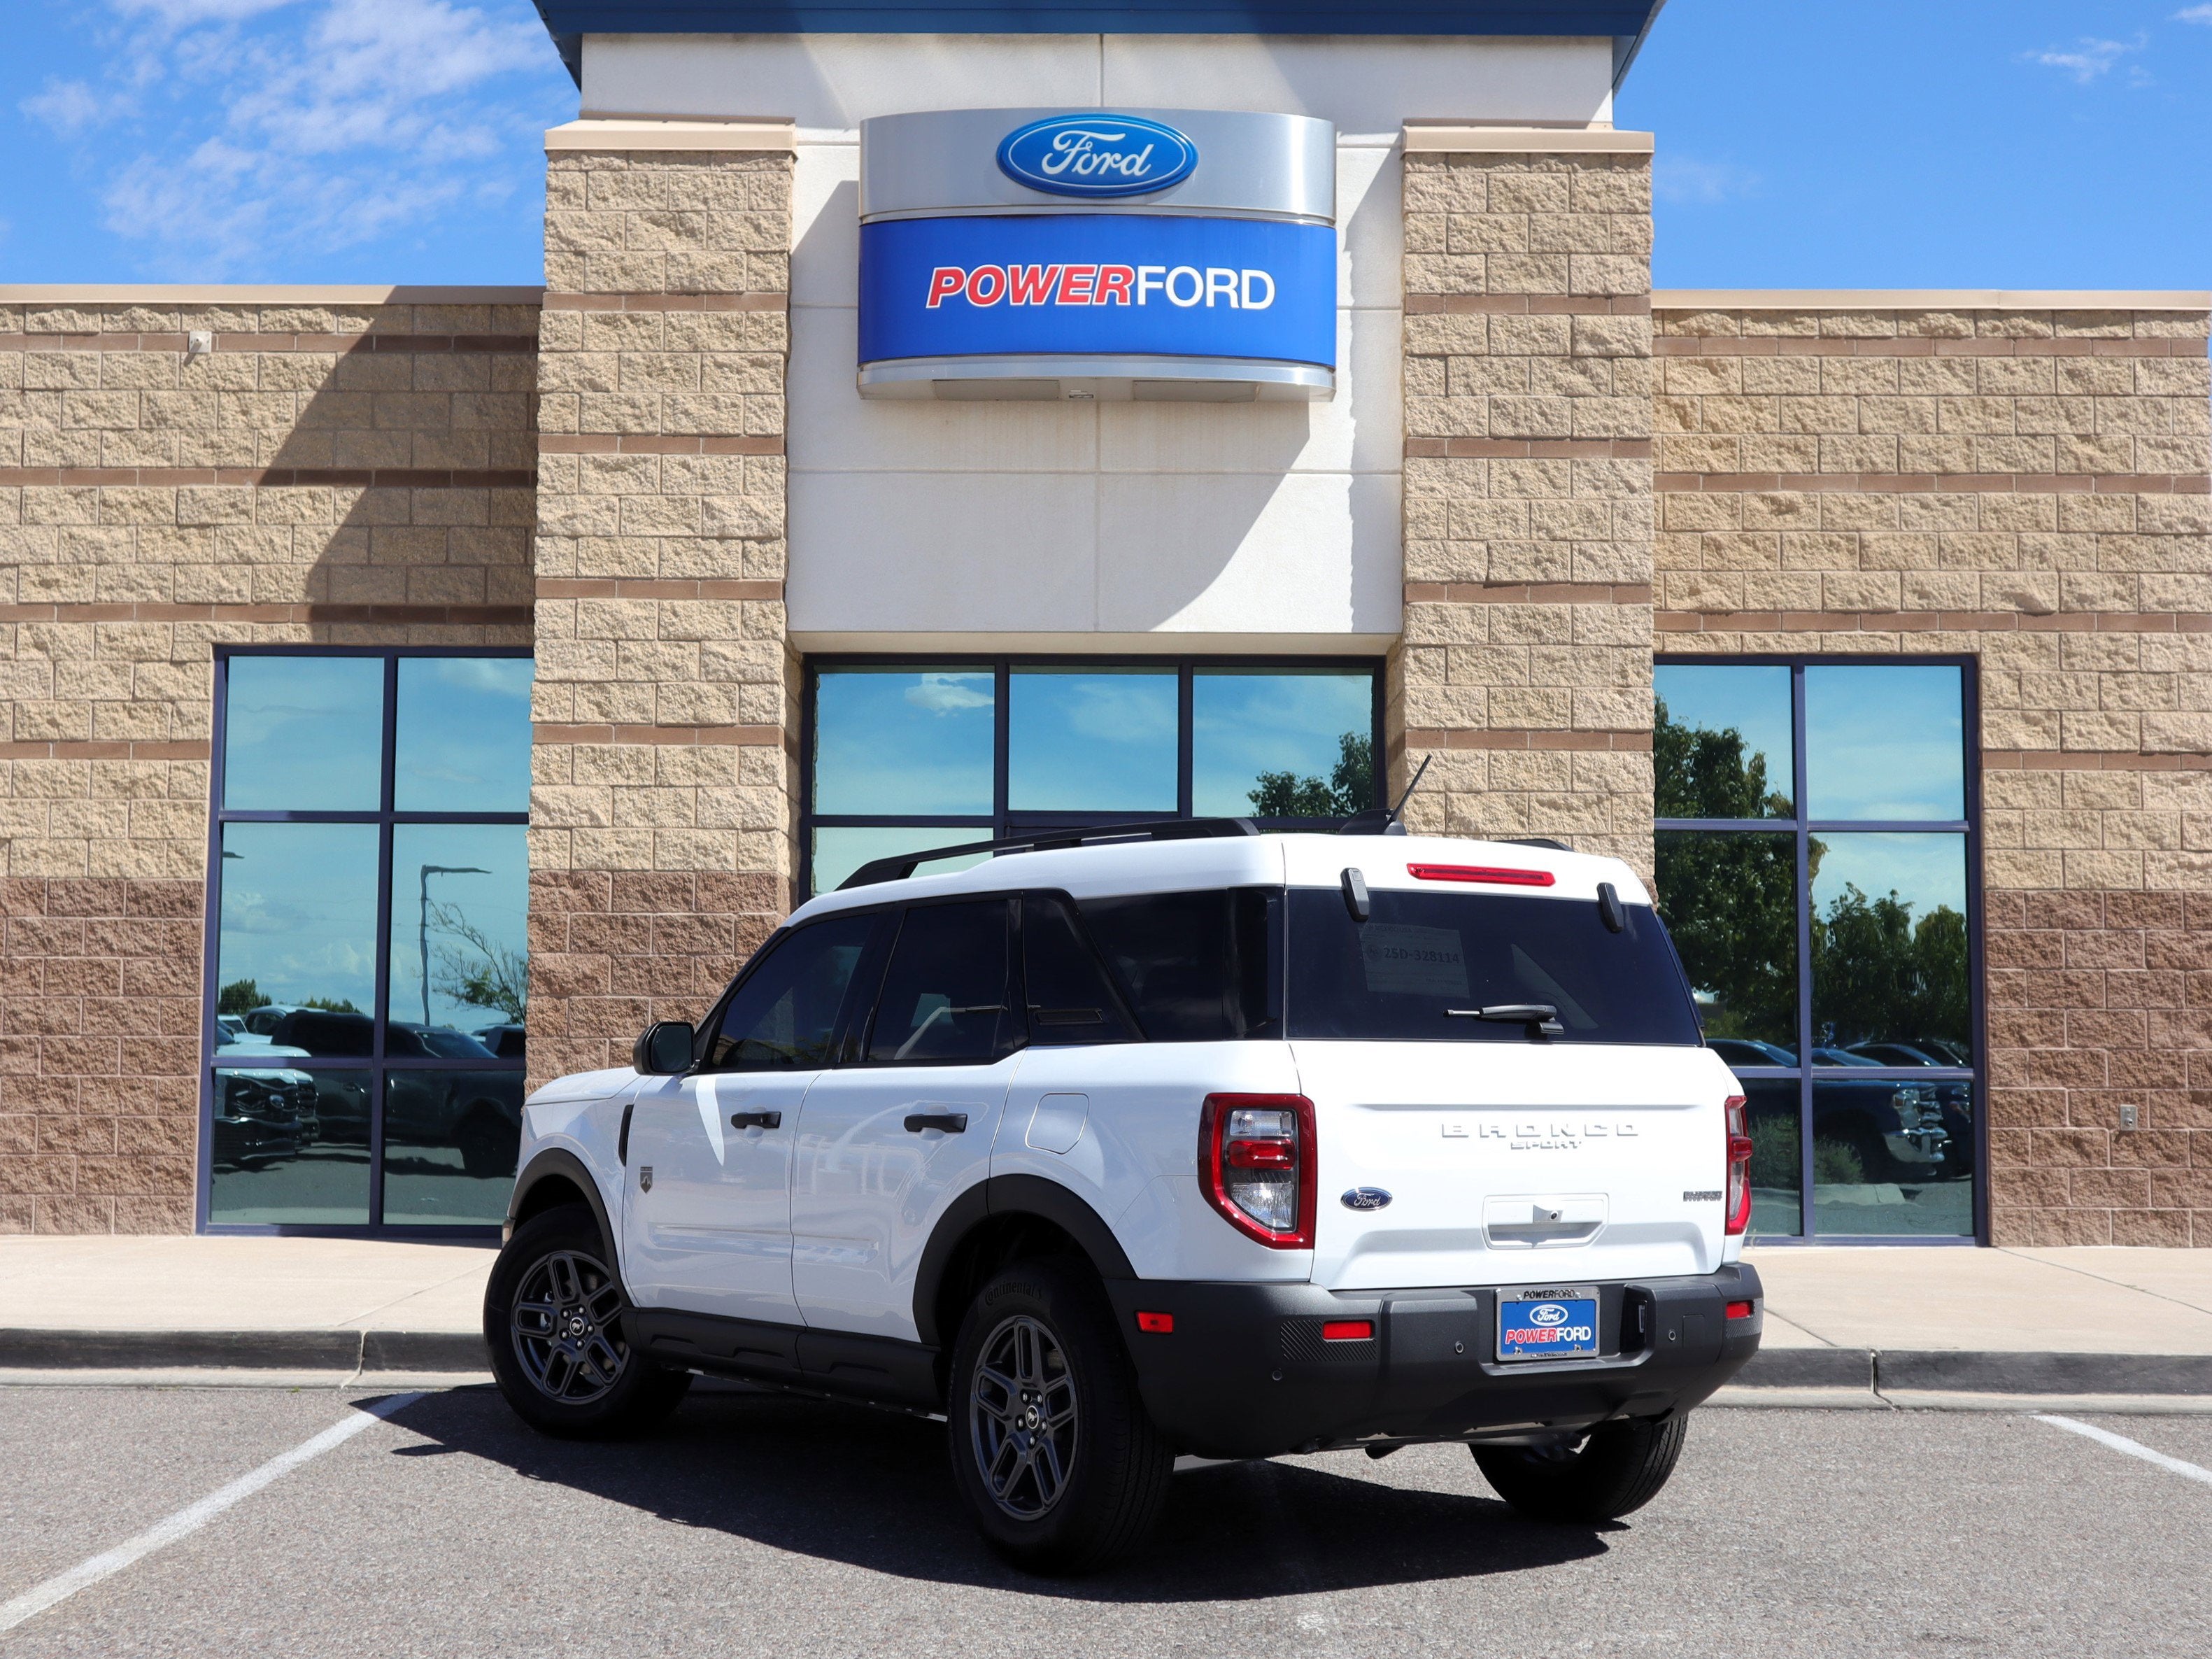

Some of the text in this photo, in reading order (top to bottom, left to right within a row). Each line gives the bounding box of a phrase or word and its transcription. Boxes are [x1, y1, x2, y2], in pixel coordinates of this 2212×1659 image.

[1042, 129, 1154, 176] Ford
[926, 263, 1276, 310] POWERFORD
[1441, 1122, 1639, 1138] BRONCO
[1510, 1141, 1582, 1150] SPORT
[1354, 1192, 1381, 1206] Ford
[1524, 1289, 1575, 1299] POWERFORD
[1538, 1308, 1561, 1321] Ford
[1505, 1326, 1591, 1344] POWERFORD
